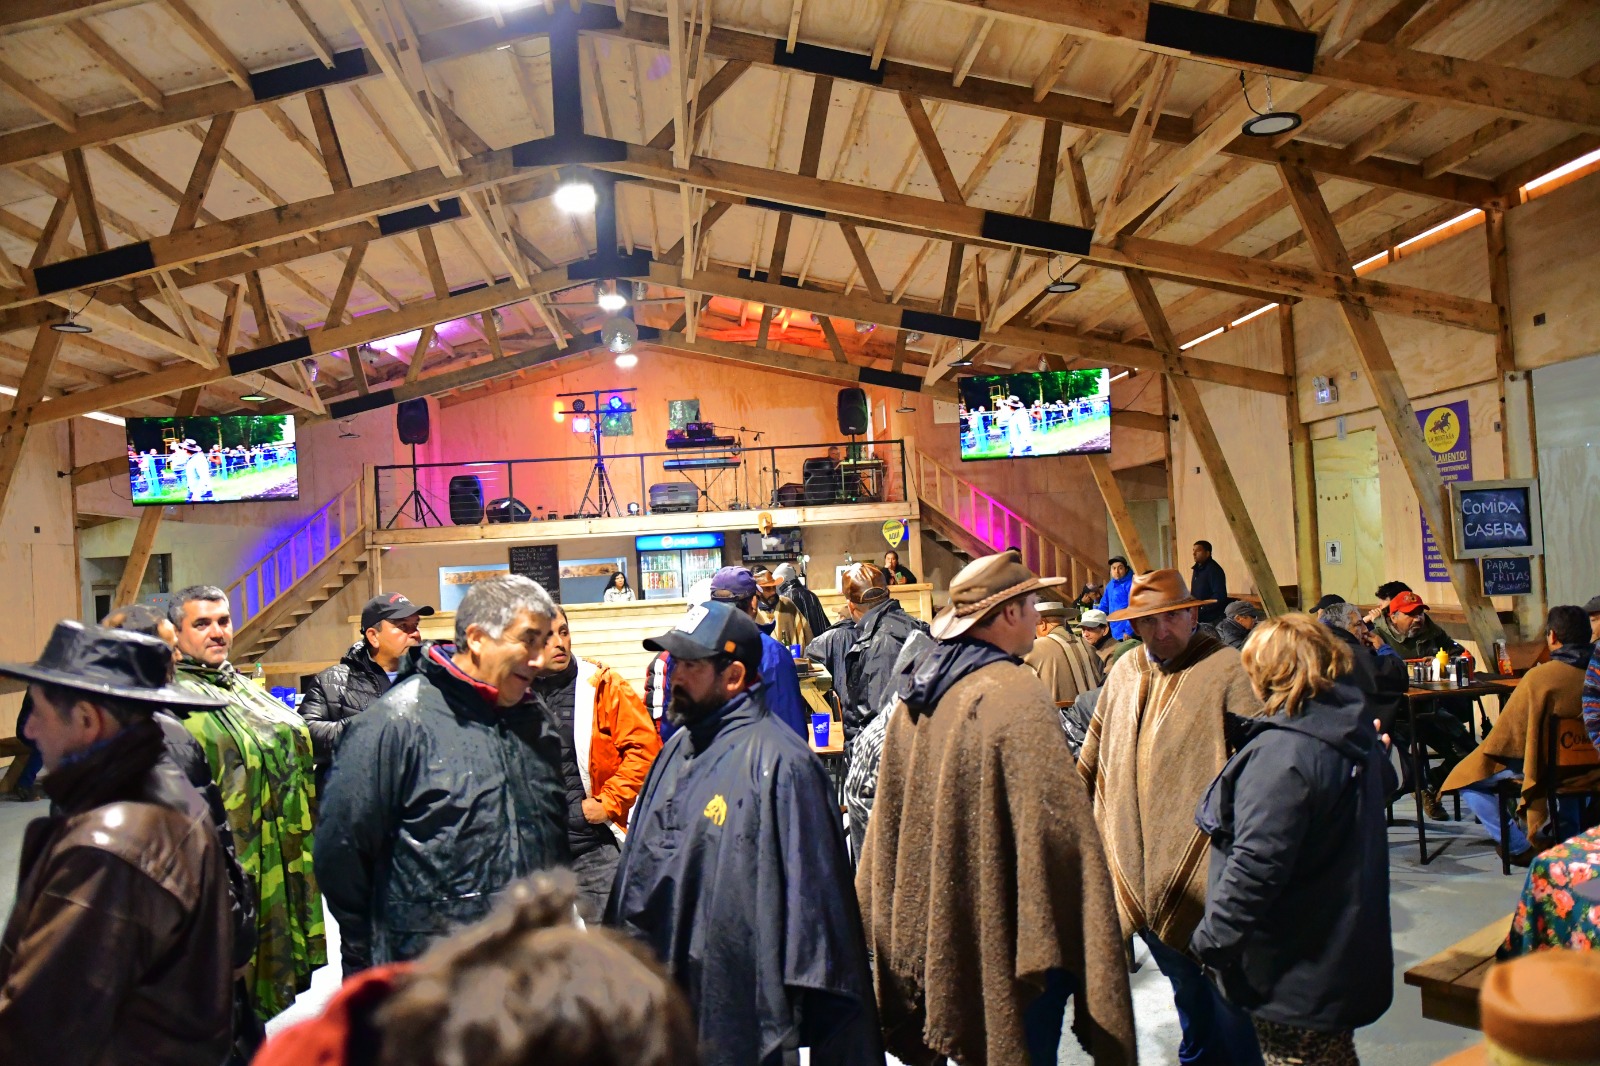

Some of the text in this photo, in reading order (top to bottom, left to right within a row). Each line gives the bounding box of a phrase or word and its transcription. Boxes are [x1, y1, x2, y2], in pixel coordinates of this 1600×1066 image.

[1433, 450, 1467, 463] LAMENTO!
[1465, 522, 1527, 537] CASERA
[1485, 560, 1516, 572] PAPAS
[1492, 571, 1530, 582] FRITAS
